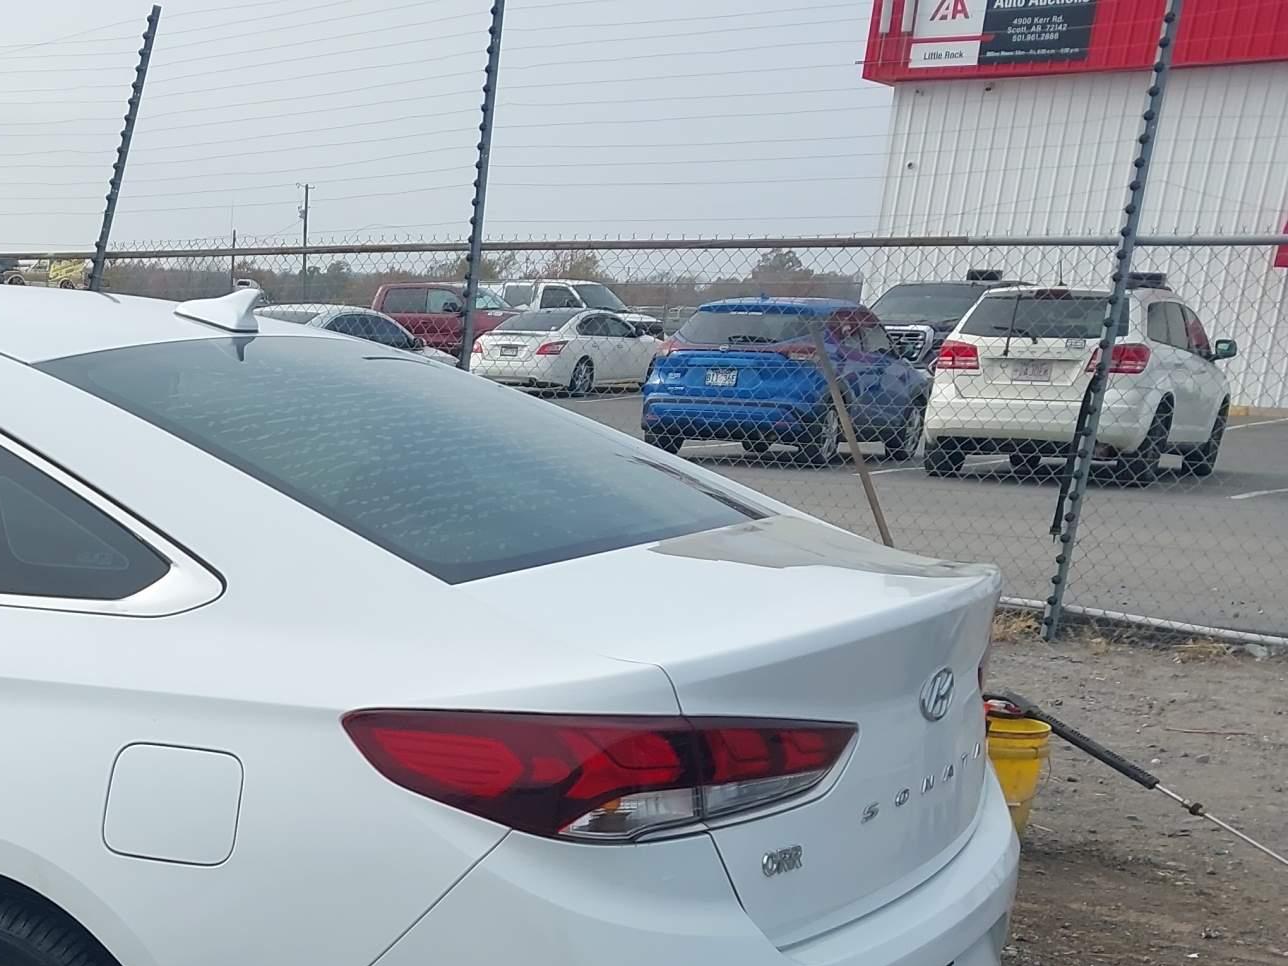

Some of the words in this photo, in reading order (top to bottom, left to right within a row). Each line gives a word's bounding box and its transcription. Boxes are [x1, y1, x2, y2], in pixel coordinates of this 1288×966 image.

[1012, 17, 1032, 25] 4900
[1033, 16, 1050, 24] Kerr
[923, 51, 943, 60] Little
[944, 50, 964, 60] Rock
